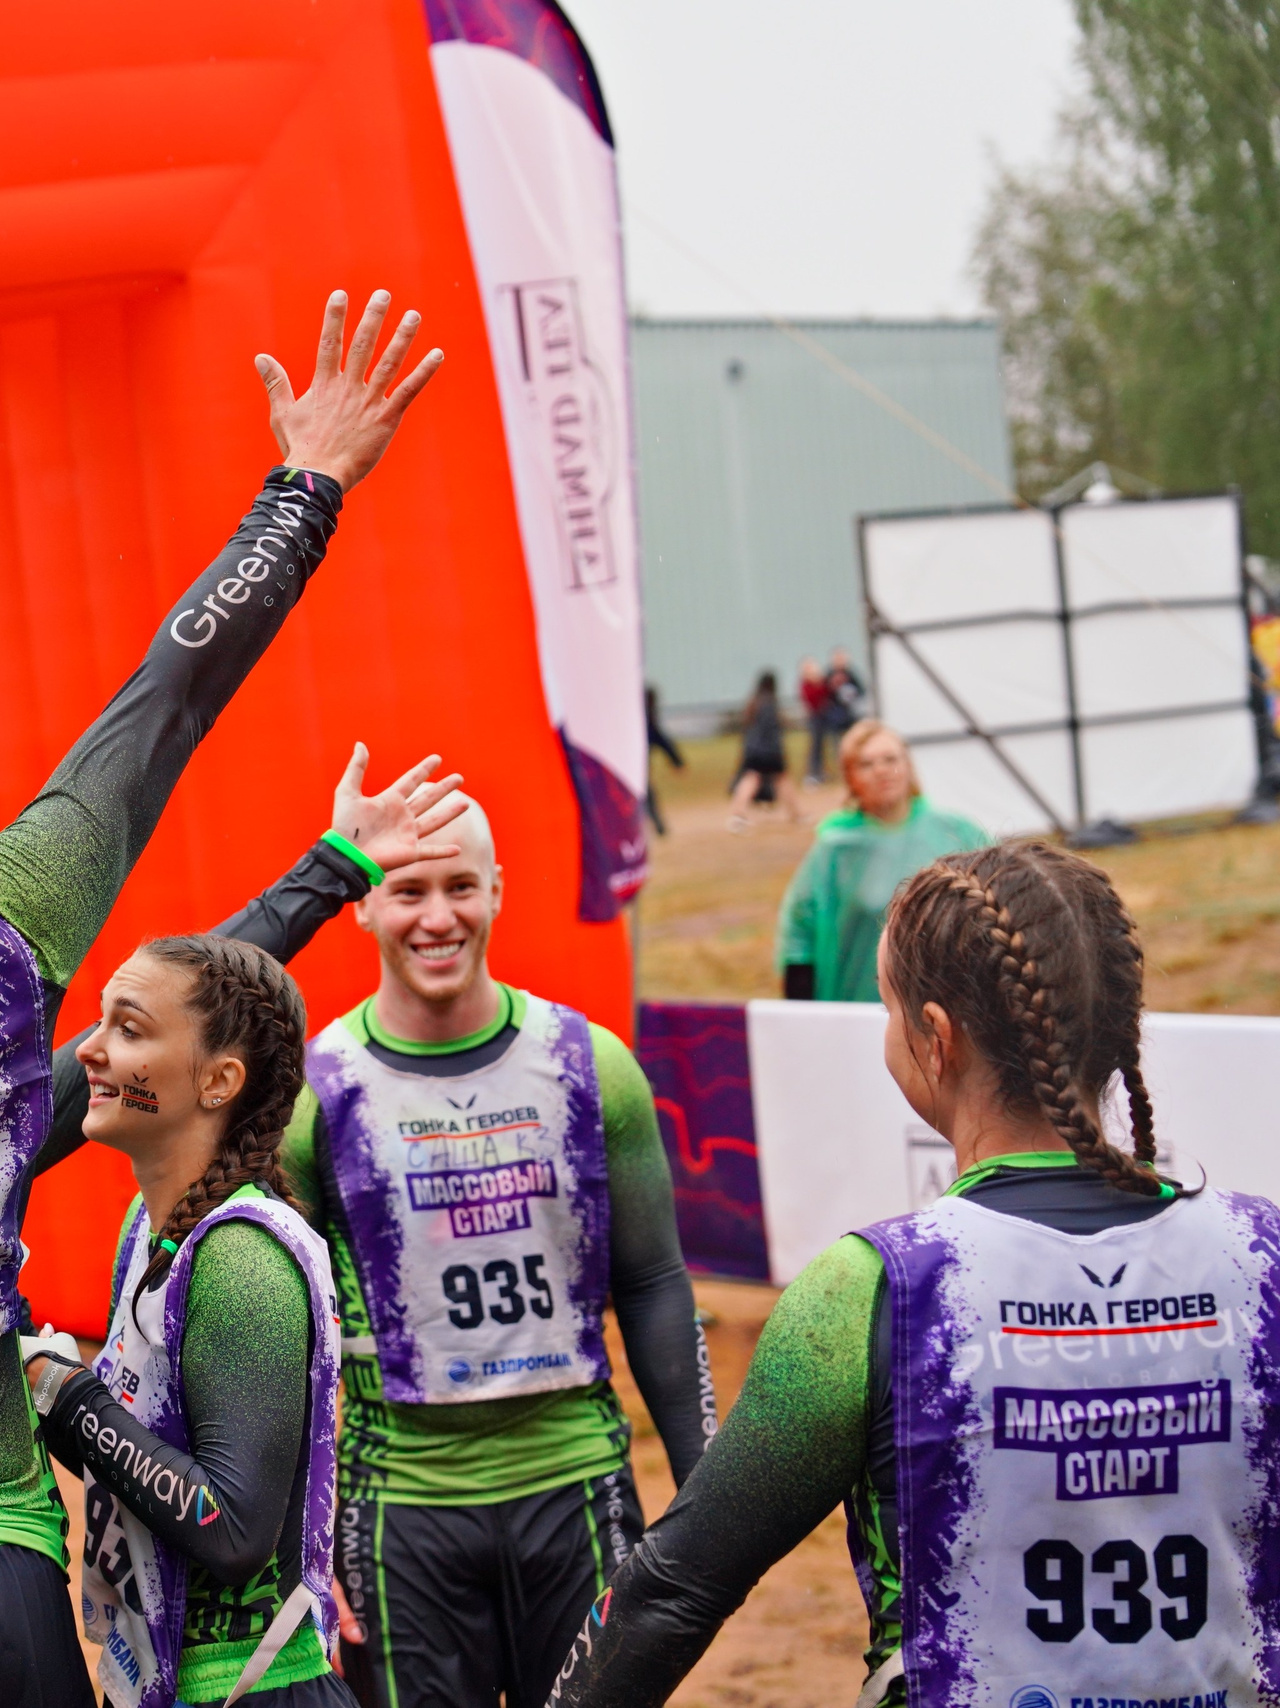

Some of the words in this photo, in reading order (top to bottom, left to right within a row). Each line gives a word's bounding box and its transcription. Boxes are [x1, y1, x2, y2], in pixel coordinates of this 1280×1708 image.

[121, 1097, 159, 1114] ГЕРОЕВ
[123, 1084, 158, 1101] ГОНКА
[399, 1117, 461, 1137] ГОНКА
[465, 1105, 540, 1131] ГЕРОЕВ
[410, 1158, 553, 1206] МАССОВЫЙ
[452, 1198, 530, 1236] СТАРТ
[442, 1253, 555, 1331] 935
[998, 1299, 1098, 1326] ГОНКА
[1106, 1292, 1218, 1325] ГЕРОЕВ
[1004, 1378, 1221, 1443] МАССОВЫЙ
[87, 1450, 154, 1515] GOBAL
[1064, 1447, 1171, 1495] СТАРТ
[1023, 1534, 1209, 1644] 939
